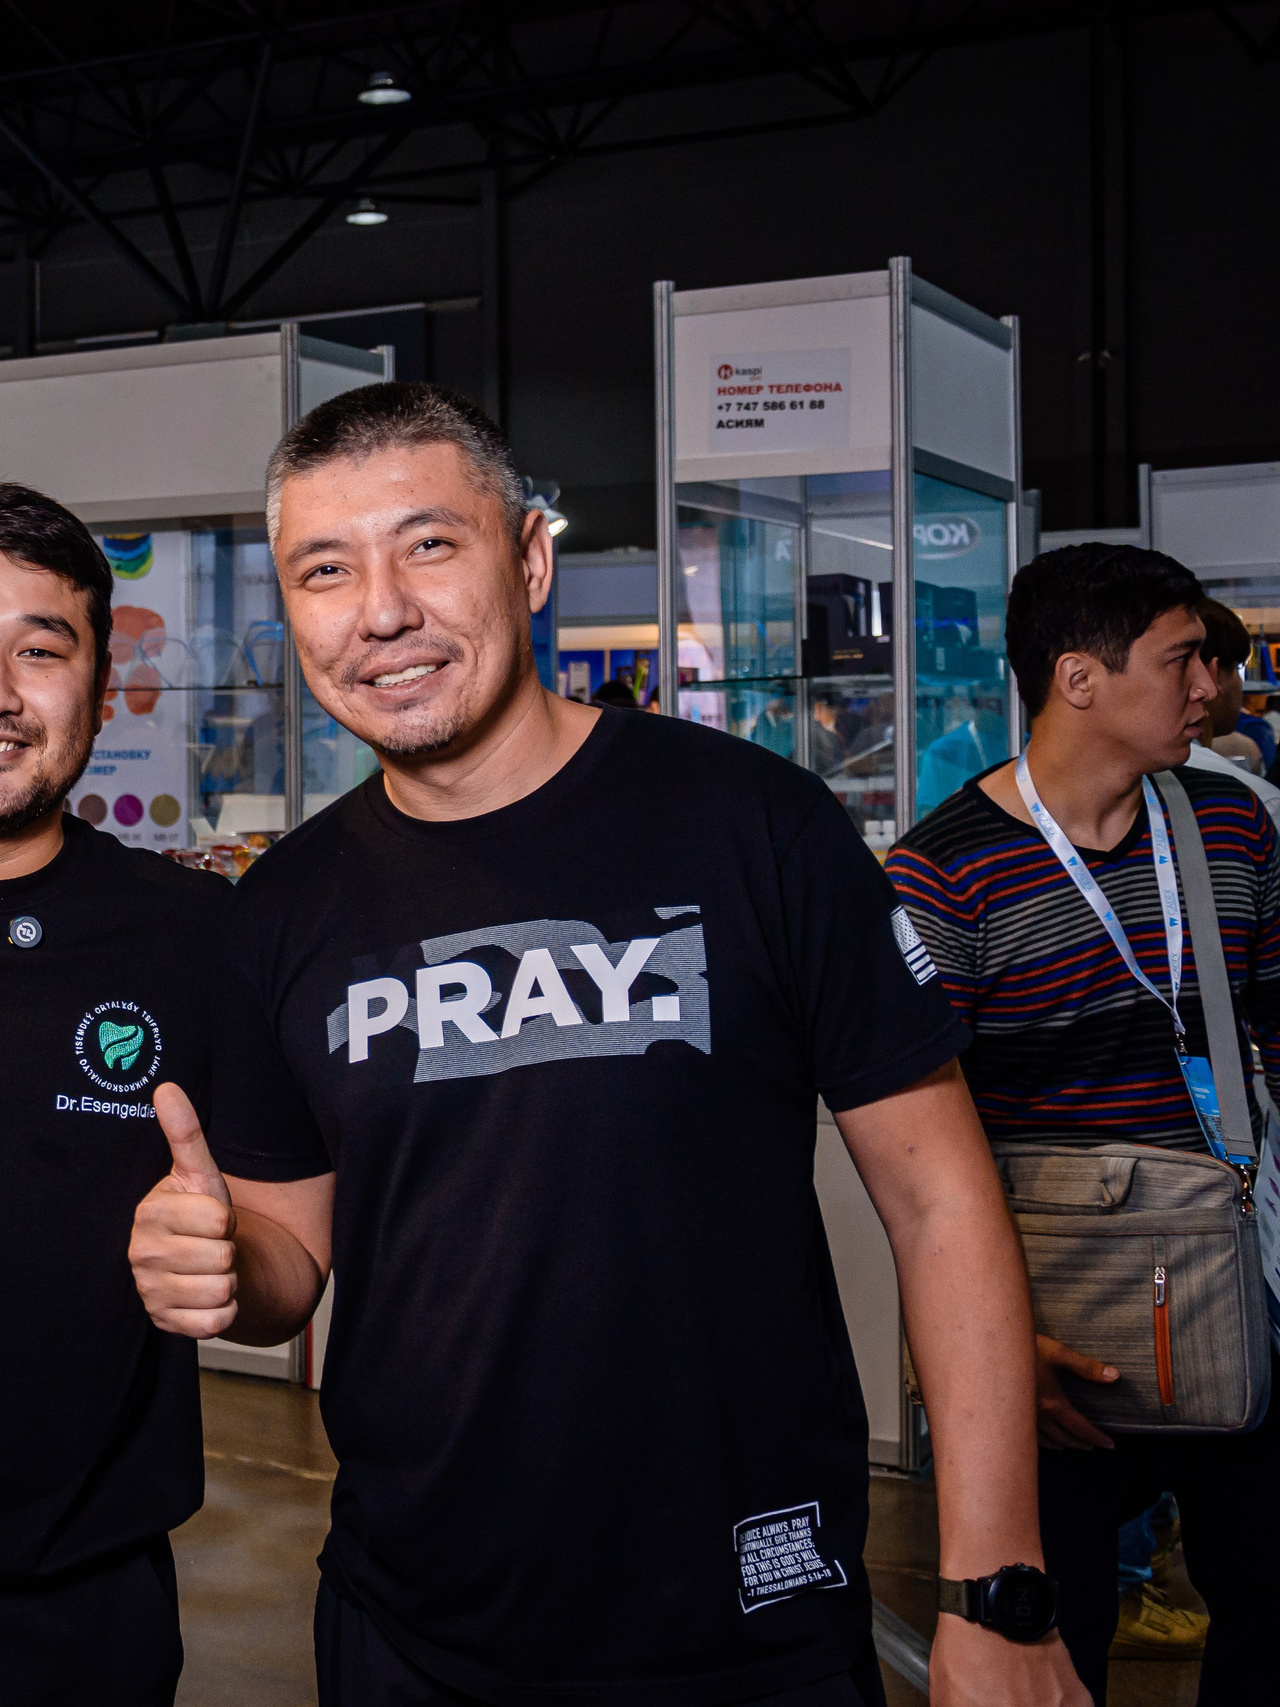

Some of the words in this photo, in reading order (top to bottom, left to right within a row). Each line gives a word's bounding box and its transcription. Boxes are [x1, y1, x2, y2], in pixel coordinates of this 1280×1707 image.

[717, 385, 764, 396] НОМЕР
[768, 382, 843, 395] ТЕЛЕФОНА
[717, 402, 732, 412] +7
[736, 401, 759, 411] 747
[789, 400, 805, 410] 61
[716, 418, 765, 429] АСИЯМ
[92, 750, 151, 760] СТАНОВКУ
[347, 938, 680, 1064] PRAY.
[56, 1094, 157, 1119] Dr.Esengeldie
[791, 1516, 810, 1530] PRAY
[774, 1534, 788, 1545] GIVE
[788, 1527, 812, 1541] THANKS
[741, 1564, 757, 1577] FOR
[756, 1561, 773, 1573] THIS
[772, 1559, 781, 1568] IS
[780, 1553, 801, 1566] GOD'S
[801, 1548, 820, 1562] WILL
[746, 1551, 760, 1563] ALL
[743, 1575, 759, 1587] FOR
[758, 1571, 773, 1583] YOU
[773, 1569, 781, 1579] IN
[780, 1564, 804, 1577] CHRIST
[803, 1559, 826, 1571] JESUS.
[756, 1576, 808, 1595] THESSALONIANS
